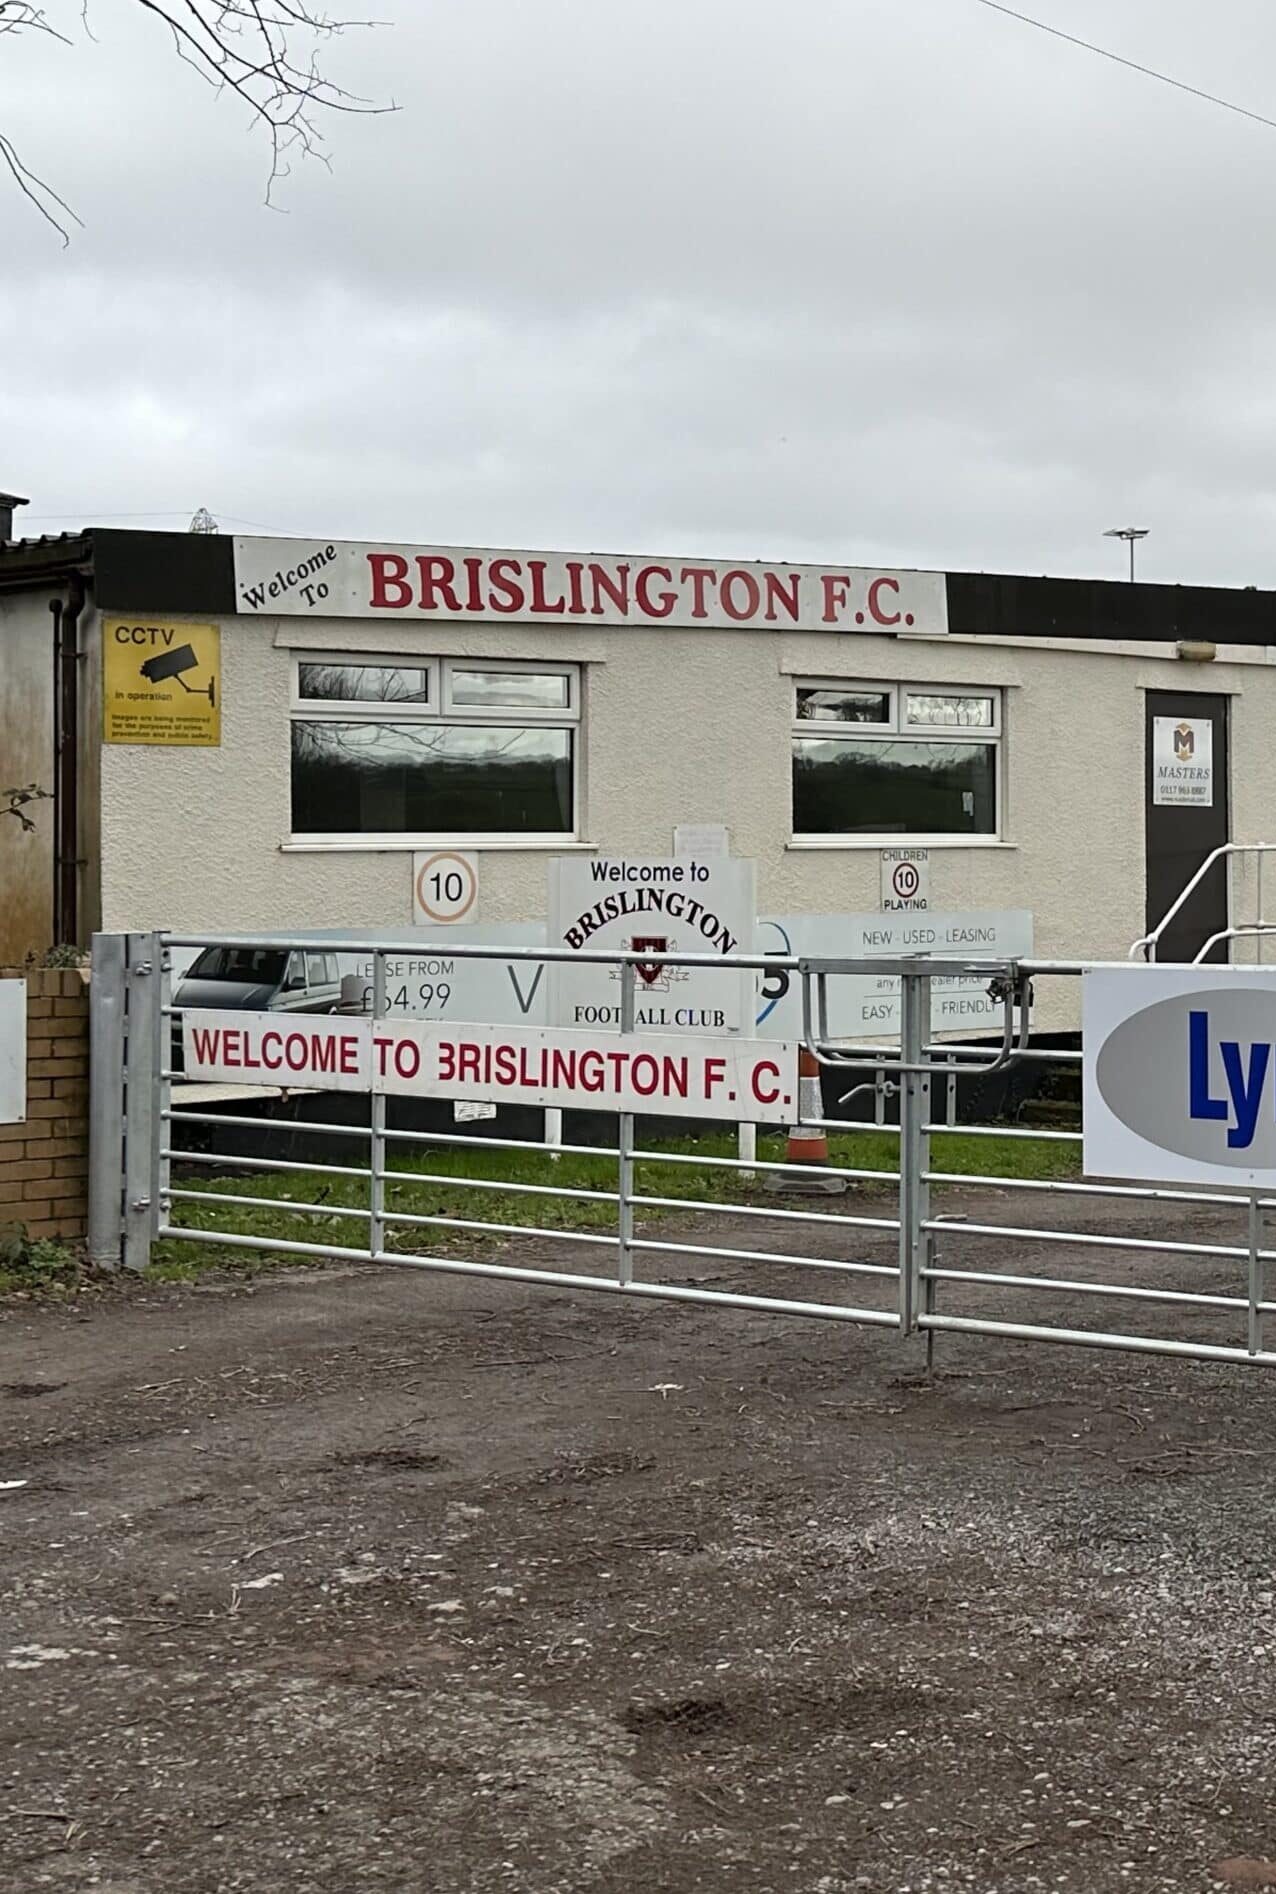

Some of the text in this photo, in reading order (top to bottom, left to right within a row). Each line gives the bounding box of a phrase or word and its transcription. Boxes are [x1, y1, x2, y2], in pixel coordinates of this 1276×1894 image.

[242, 544, 338, 610] Welcome
[300, 582, 329, 607] To
[366, 553, 915, 626] BRISLINGTON F.C.
[115, 626, 175, 646] CCTV
[127, 692, 173, 701] operation
[1158, 766, 1210, 780] MASTERS
[882, 850, 928, 861] CHILDREN
[591, 861, 710, 882] Welcome to
[898, 871, 914, 888] 10
[430, 872, 463, 902] 10
[884, 899, 927, 911] PLAYING
[563, 887, 737, 955] BRISLINGTON
[863, 931, 893, 945] NEW
[903, 929, 935, 944] USED
[946, 928, 996, 943] LEASING
[356, 960, 454, 978] LESE FROM
[574, 1006, 725, 1027] FOOTALL CLUB
[862, 1005, 893, 1020] EASY
[192, 1028, 791, 1105] WELCOME TO BRISLINGTON F. C.
